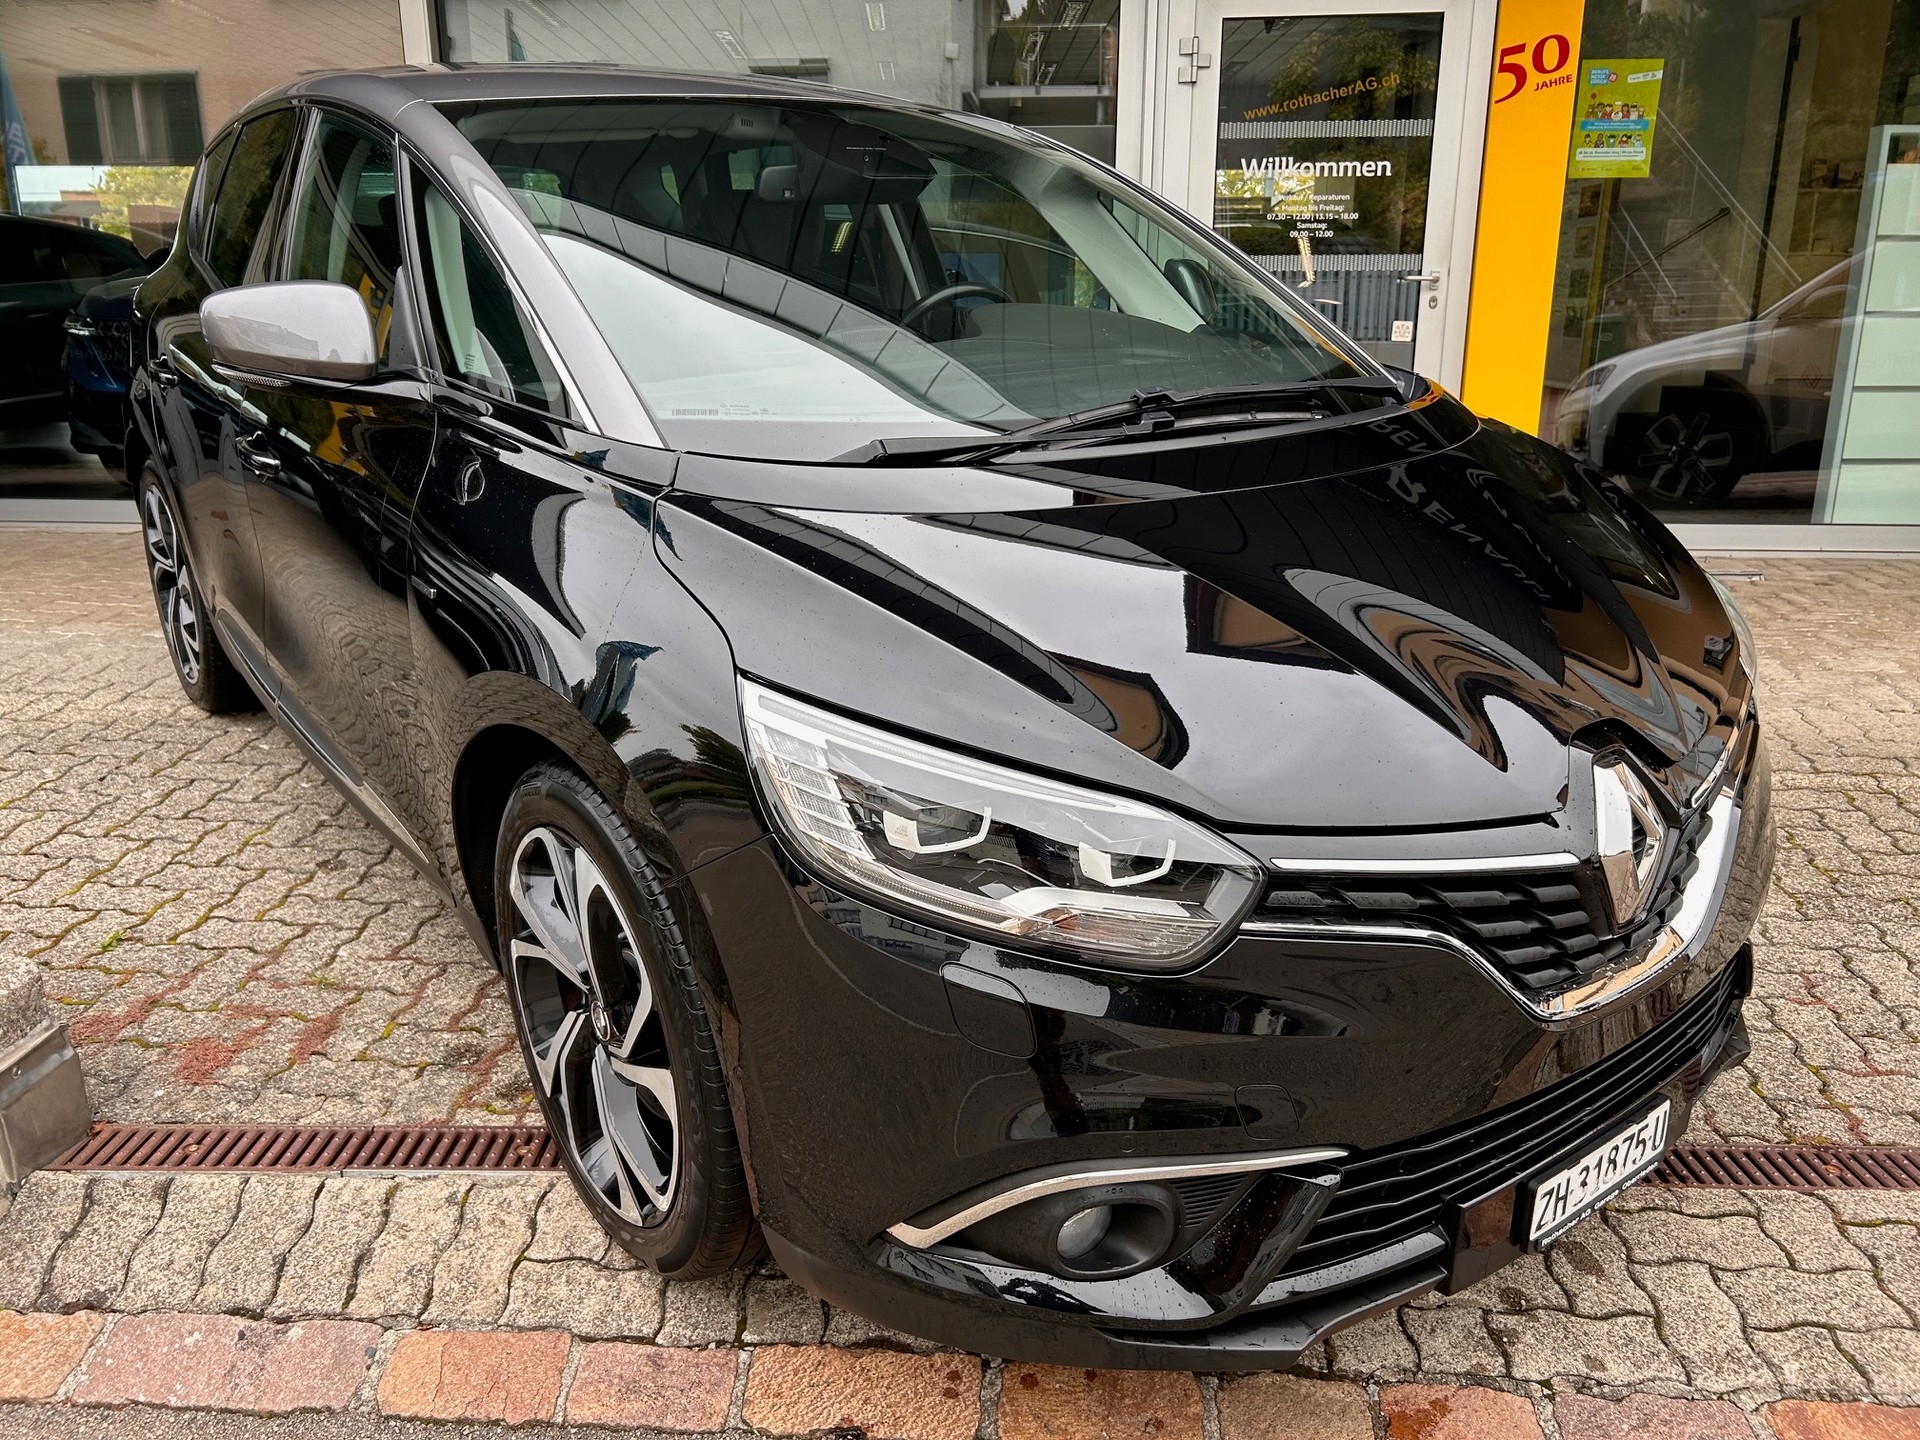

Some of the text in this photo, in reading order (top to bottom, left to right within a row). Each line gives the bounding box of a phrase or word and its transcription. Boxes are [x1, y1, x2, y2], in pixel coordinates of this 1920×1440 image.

[1494, 33, 1571, 105] 50
[1534, 73, 1573, 92] JAHRE
[1243, 72, 1400, 121] www.rothacherAG.ch
[1241, 156, 1392, 178] Willkommen
[1319, 204, 1345, 212] Freitag:
[1296, 222, 1327, 230] Samstag:
[1315, 230, 1333, 238] 12.00
[1541, 1217, 1580, 1247] Rothacher
[1579, 1208, 1592, 1221] AG
